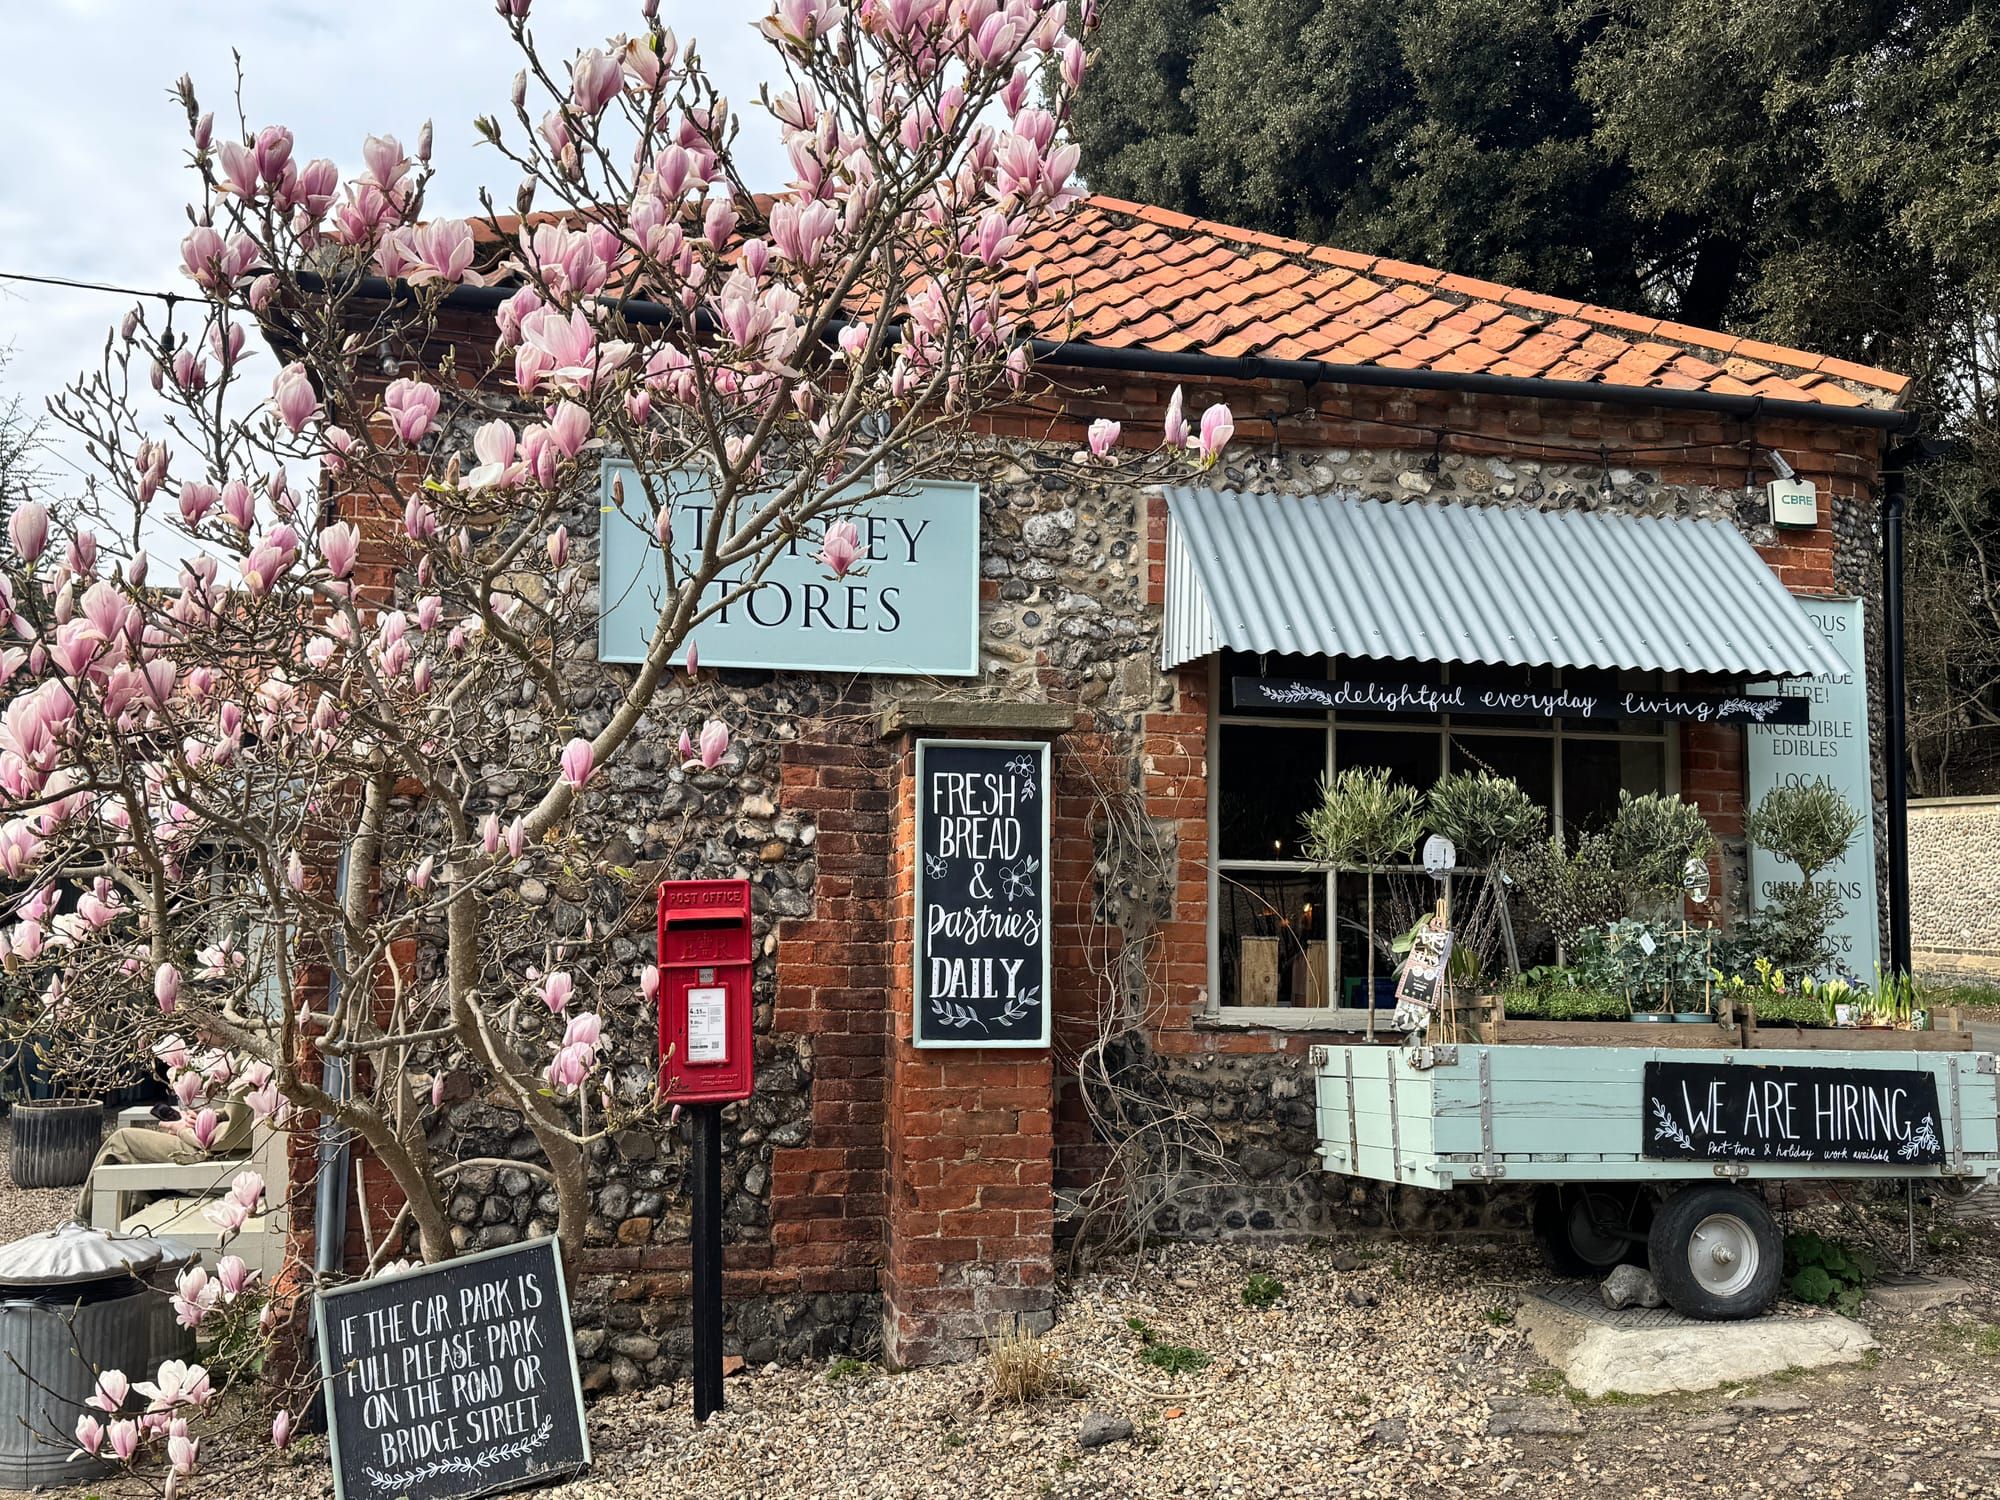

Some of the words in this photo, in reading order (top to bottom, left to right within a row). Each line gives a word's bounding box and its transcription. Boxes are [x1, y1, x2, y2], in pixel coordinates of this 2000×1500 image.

[1782, 495, 1813, 506] CBRE
[1335, 681, 1465, 712] delightful
[1480, 689, 1597, 718] everyday
[1621, 692, 1714, 722] living
[1755, 719, 1853, 738] INCREDIBLE
[1773, 739, 1838, 757] EDIBLES
[933, 772, 1016, 816] FRESH
[1775, 772, 1837, 791] LOCAL
[940, 815, 1021, 860] BREAD
[670, 892, 698, 903] POST
[702, 891, 741, 903] OFFICE
[969, 861, 994, 899] &
[929, 957, 1025, 999] DAILY
[1682, 1080, 1727, 1134] WE
[1744, 1081, 1800, 1139] ARE
[1814, 1083, 1911, 1141] HIRING
[1764, 1144, 1771, 1155] &
[1776, 1144, 1814, 1160] holiday
[1824, 1149, 1848, 1160] work
[1852, 1148, 1890, 1163] available
[341, 1315, 358, 1354] IF
[363, 1304, 406, 1349] THE
[411, 1295, 451, 1337] CAR
[460, 1279, 514, 1326] PARK
[518, 1273, 543, 1310] IS
[347, 1353, 398, 1397] FULL
[402, 1329, 480, 1384] PLEASE
[487, 1315, 544, 1362] PARK
[363, 1391, 399, 1431] ON
[403, 1378, 446, 1420] THE
[451, 1365, 503, 1409] ROAD
[514, 1355, 546, 1392] OR
[380, 1416, 463, 1468] BRIDGE
[466, 1396, 540, 1444] STREET
